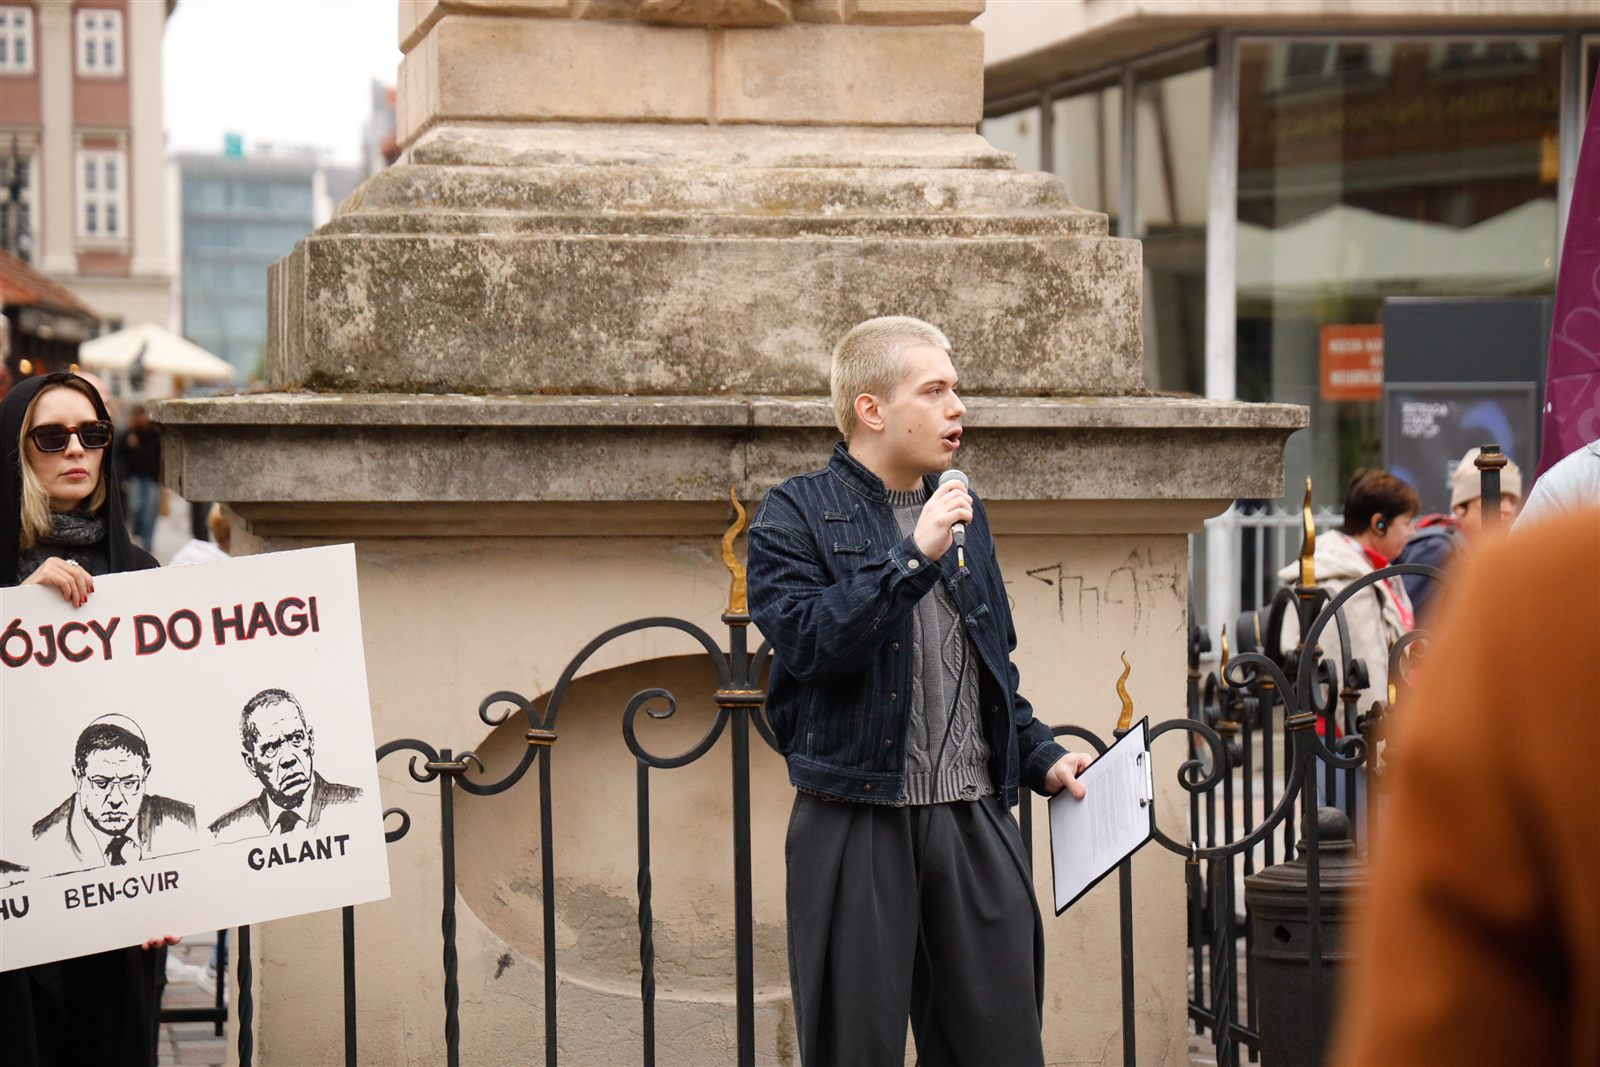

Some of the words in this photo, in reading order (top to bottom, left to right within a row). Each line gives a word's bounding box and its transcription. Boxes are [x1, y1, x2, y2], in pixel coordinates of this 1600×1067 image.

[0, 617, 120, 668] ÓJCY
[133, 608, 202, 656] DO
[211, 596, 320, 646] HAGI
[247, 834, 350, 871] GALANT
[64, 870, 180, 910] BEN-GVIR
